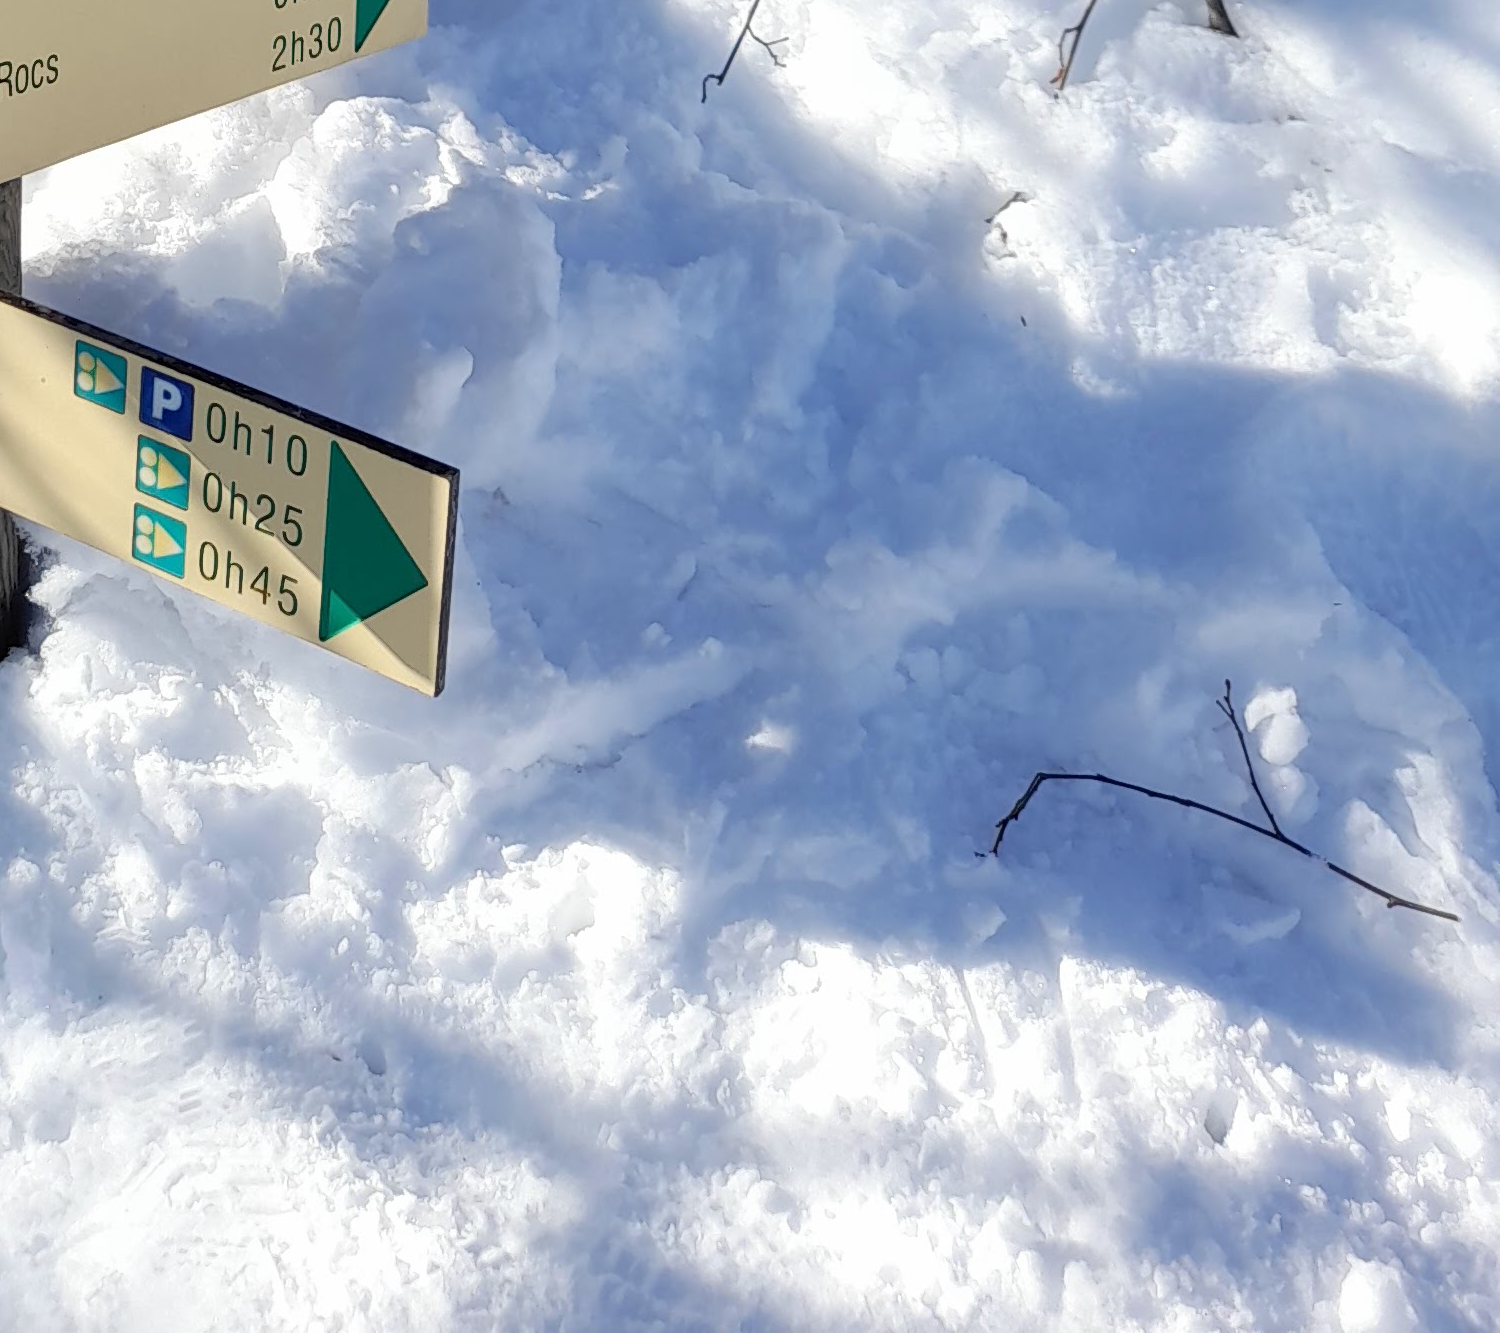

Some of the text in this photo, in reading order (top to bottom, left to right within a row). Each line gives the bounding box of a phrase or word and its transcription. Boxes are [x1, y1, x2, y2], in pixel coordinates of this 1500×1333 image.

[272, 17, 341, 72] 2h30
[207, 403, 307, 477] 0h10
[204, 472, 303, 547] 0h25
[199, 541, 298, 616] 0h45
